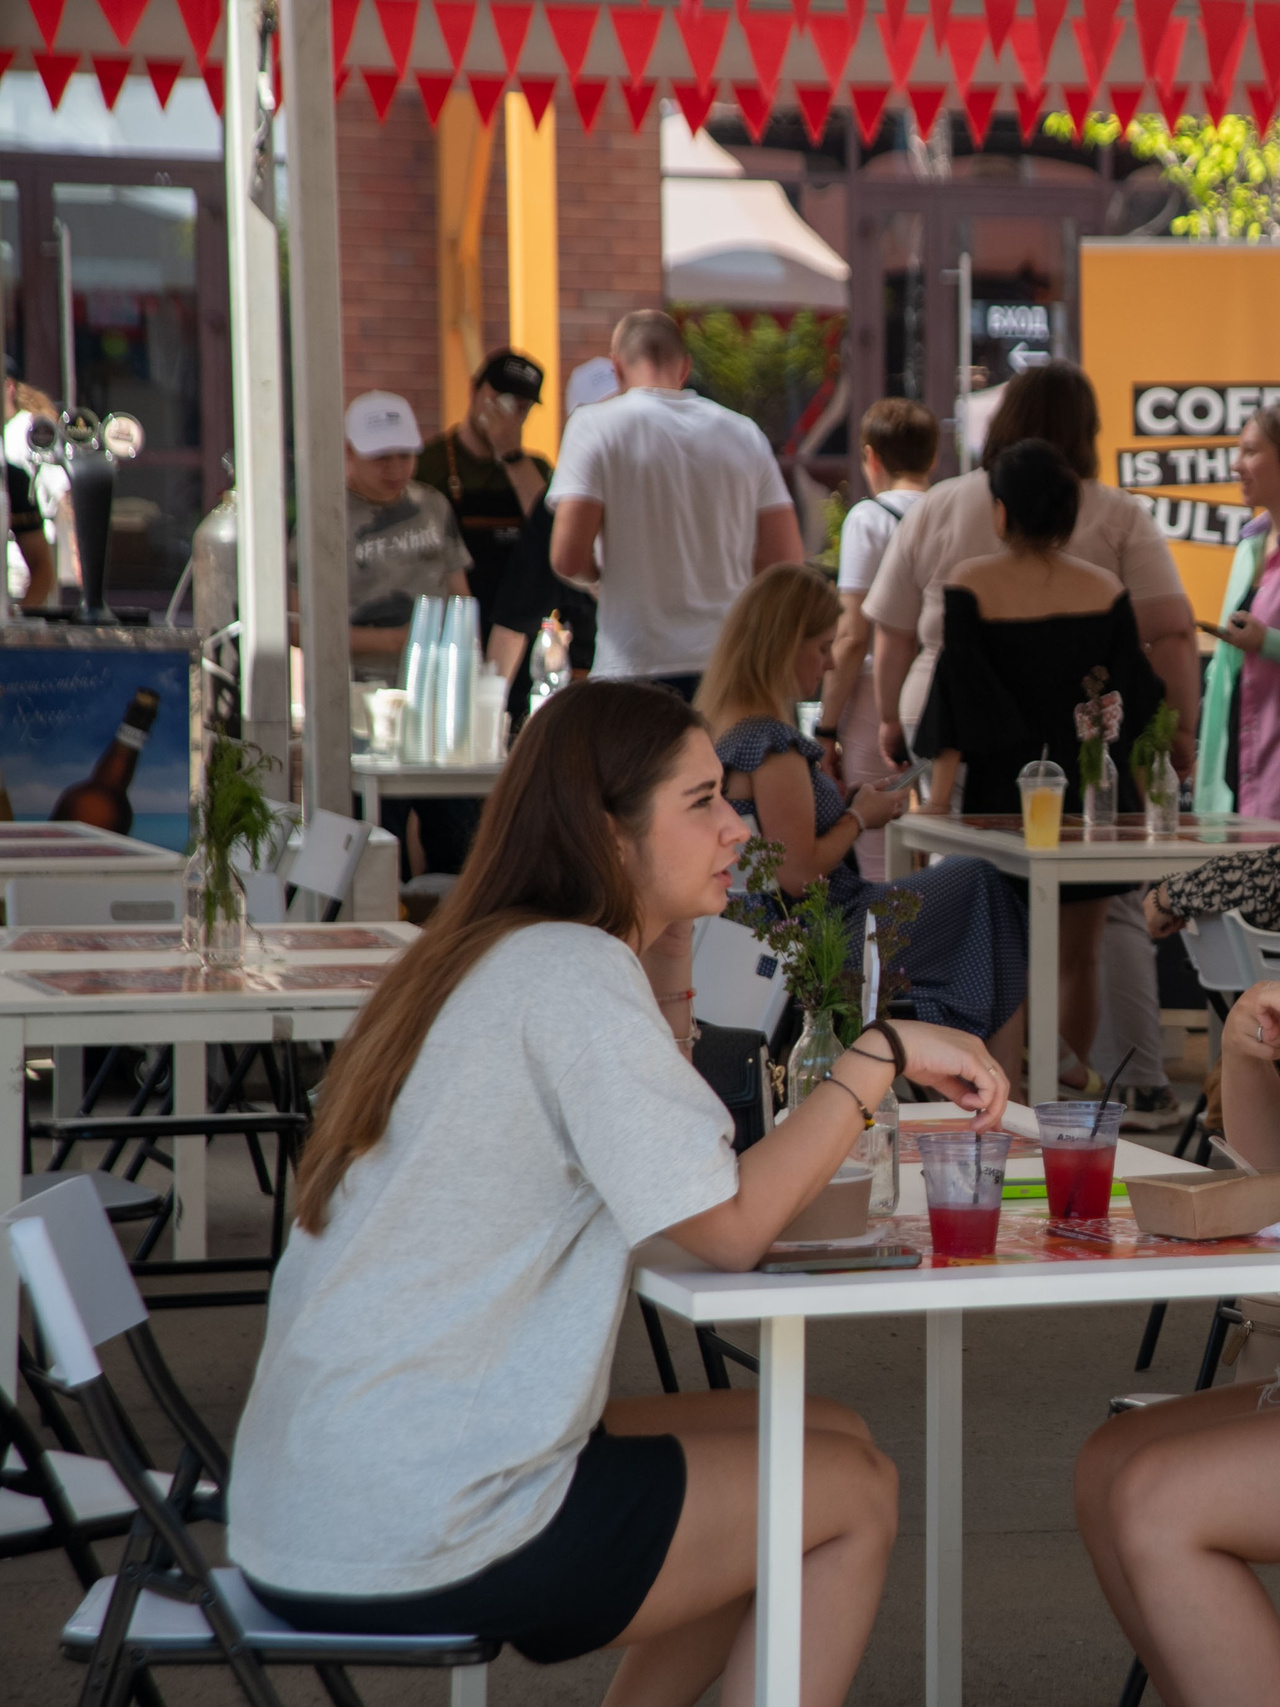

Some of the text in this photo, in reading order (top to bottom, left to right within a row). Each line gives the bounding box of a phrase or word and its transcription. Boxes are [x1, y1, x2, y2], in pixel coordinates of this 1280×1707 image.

[988, 305, 1049, 341] ВХОД
[1121, 450, 1163, 487] IS
[1134, 494, 1253, 547] ULT
